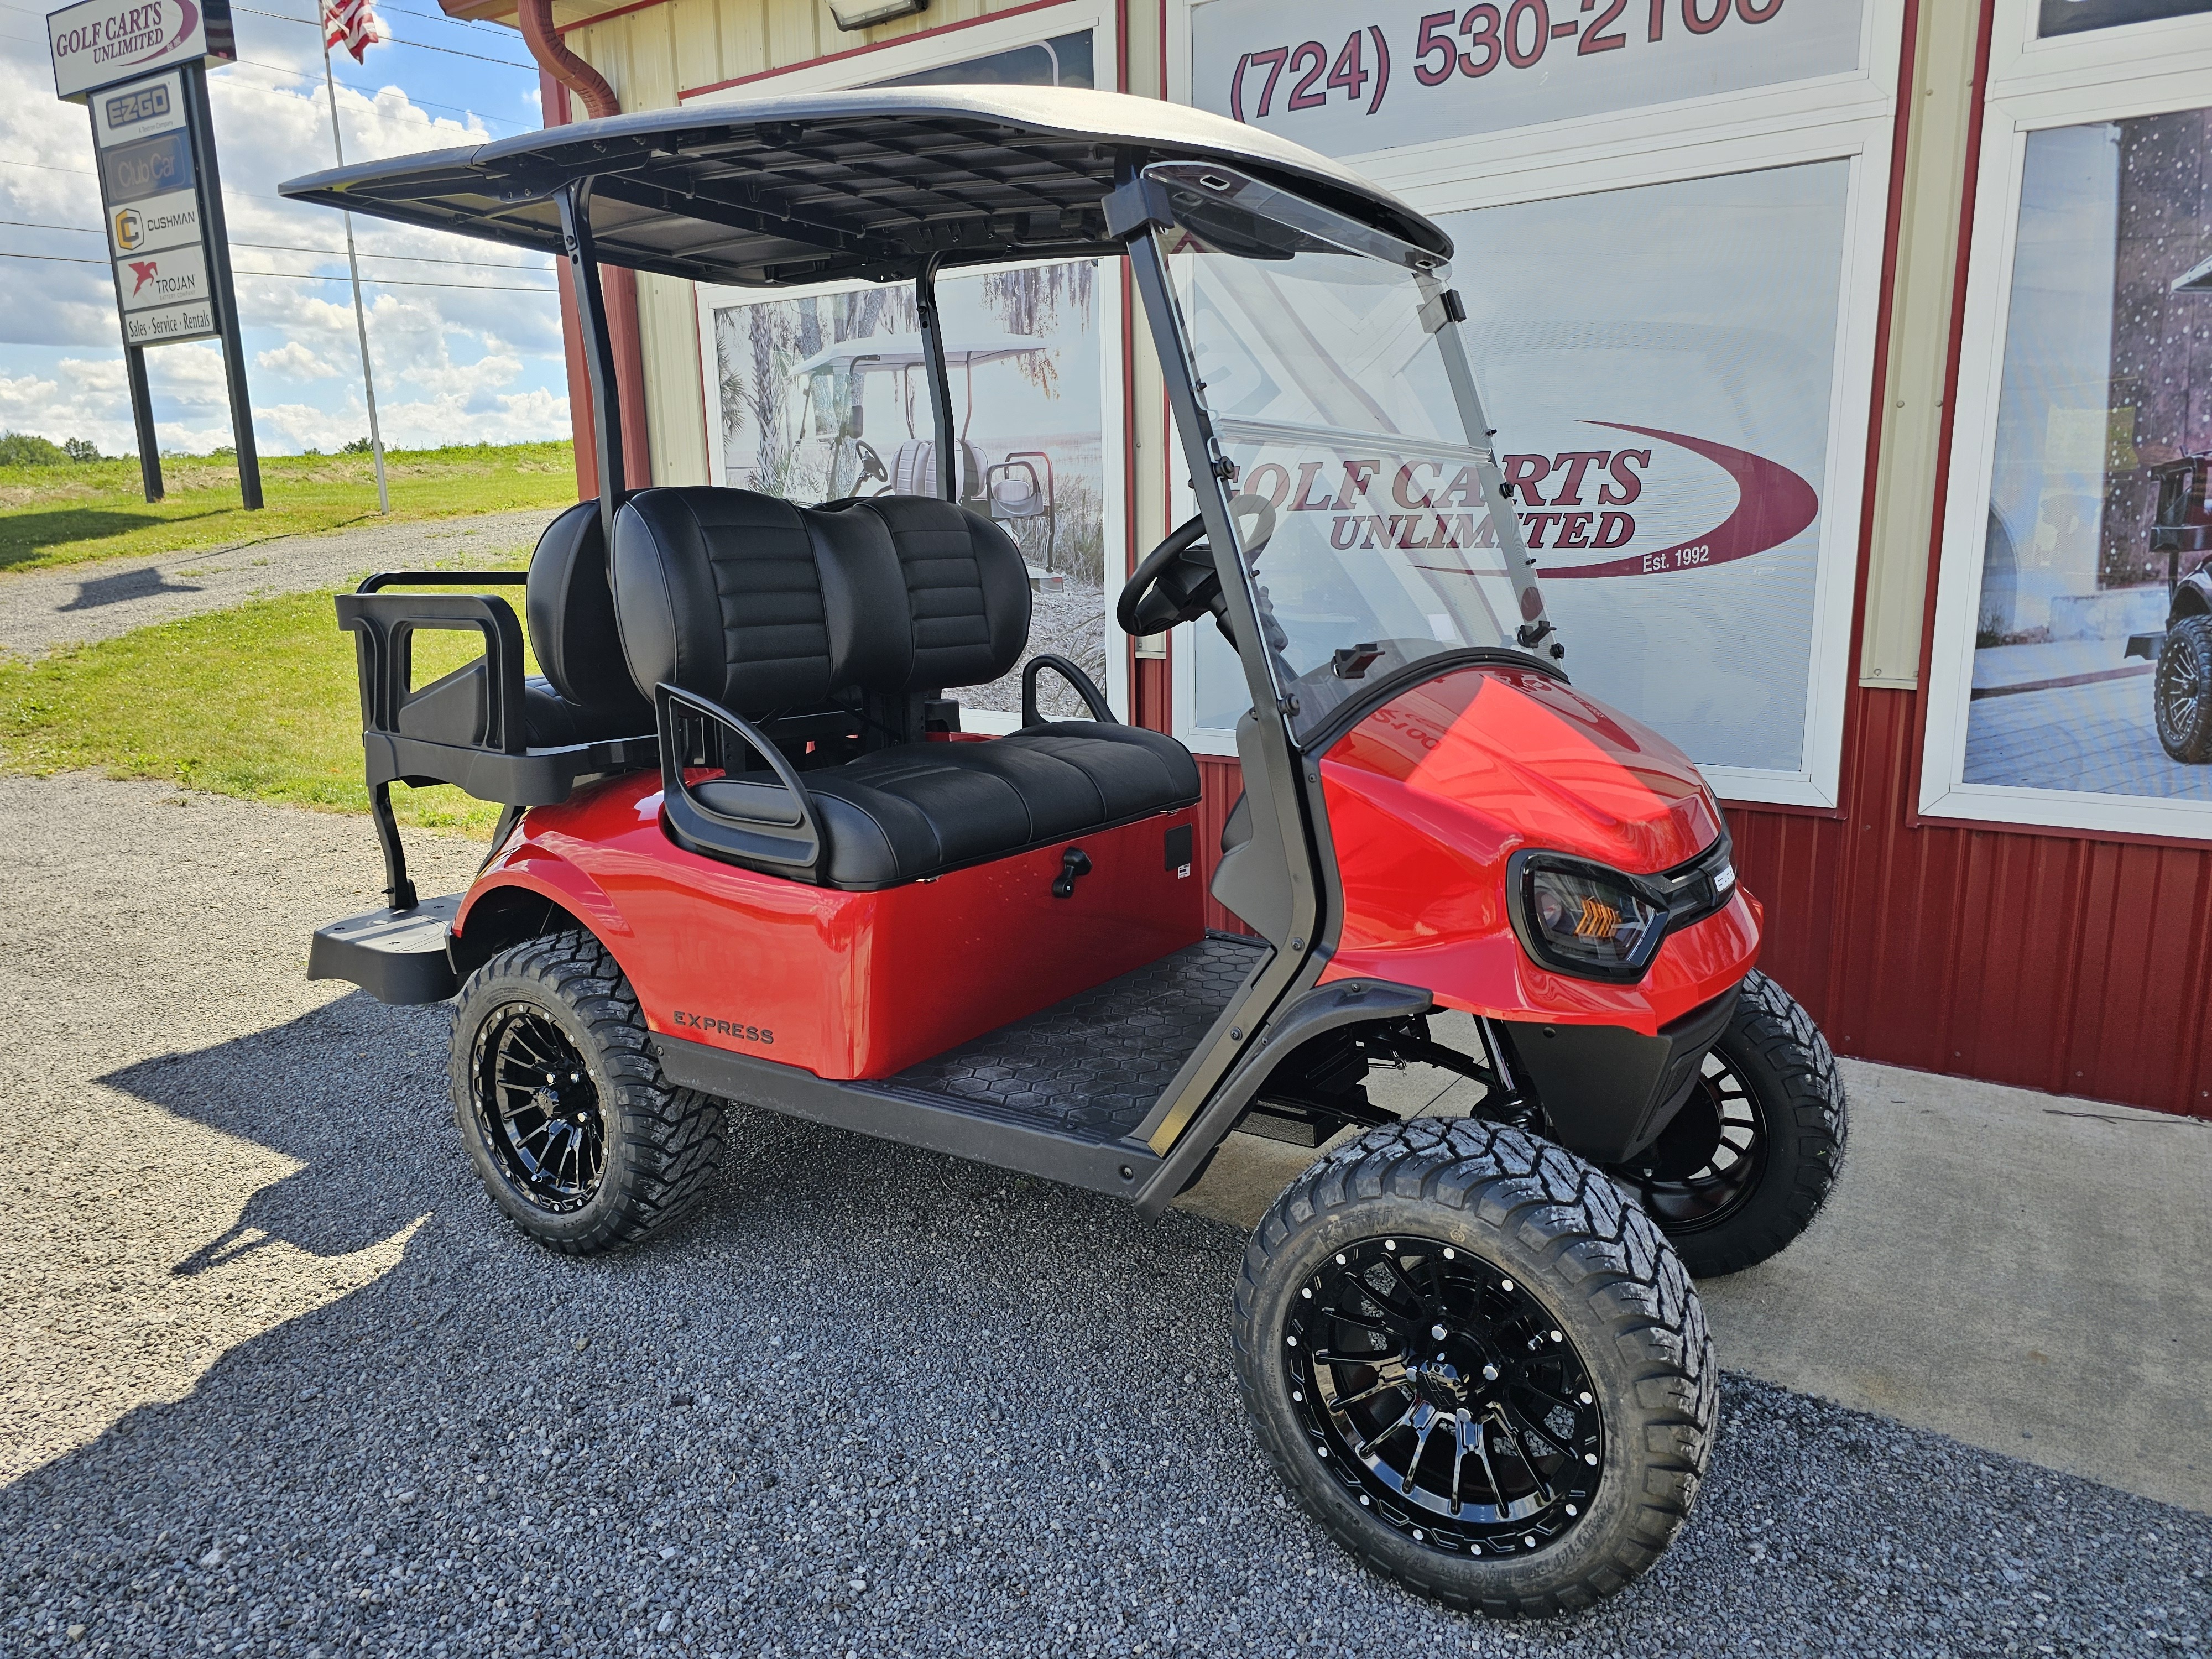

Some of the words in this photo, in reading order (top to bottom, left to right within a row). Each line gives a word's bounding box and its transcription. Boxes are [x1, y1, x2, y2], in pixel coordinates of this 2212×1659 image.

[56, 22, 101, 57] GOLF
[106, 1, 161, 41] CARTS
[93, 28, 163, 64] UNLIMITED
[1231, 26, 1390, 124] (724)
[118, 158, 150, 187] Club
[150, 153, 175, 179] Car
[147, 211, 195, 231] CUSHMAN
[156, 274, 195, 294] TROJAN
[176, 290, 196, 299] COMPANY
[129, 320, 147, 337] Sales
[152, 315, 178, 335] Service
[183, 310, 210, 330] Rentals
[1230, 460, 1380, 512] OLF
[1392, 449, 1652, 509] CARTS
[1331, 512, 1636, 550] UNLIMTED
[1643, 554, 1670, 572] Est.
[1675, 545, 1709, 566] 1992
[673, 1010, 774, 1045] EXPRESS
